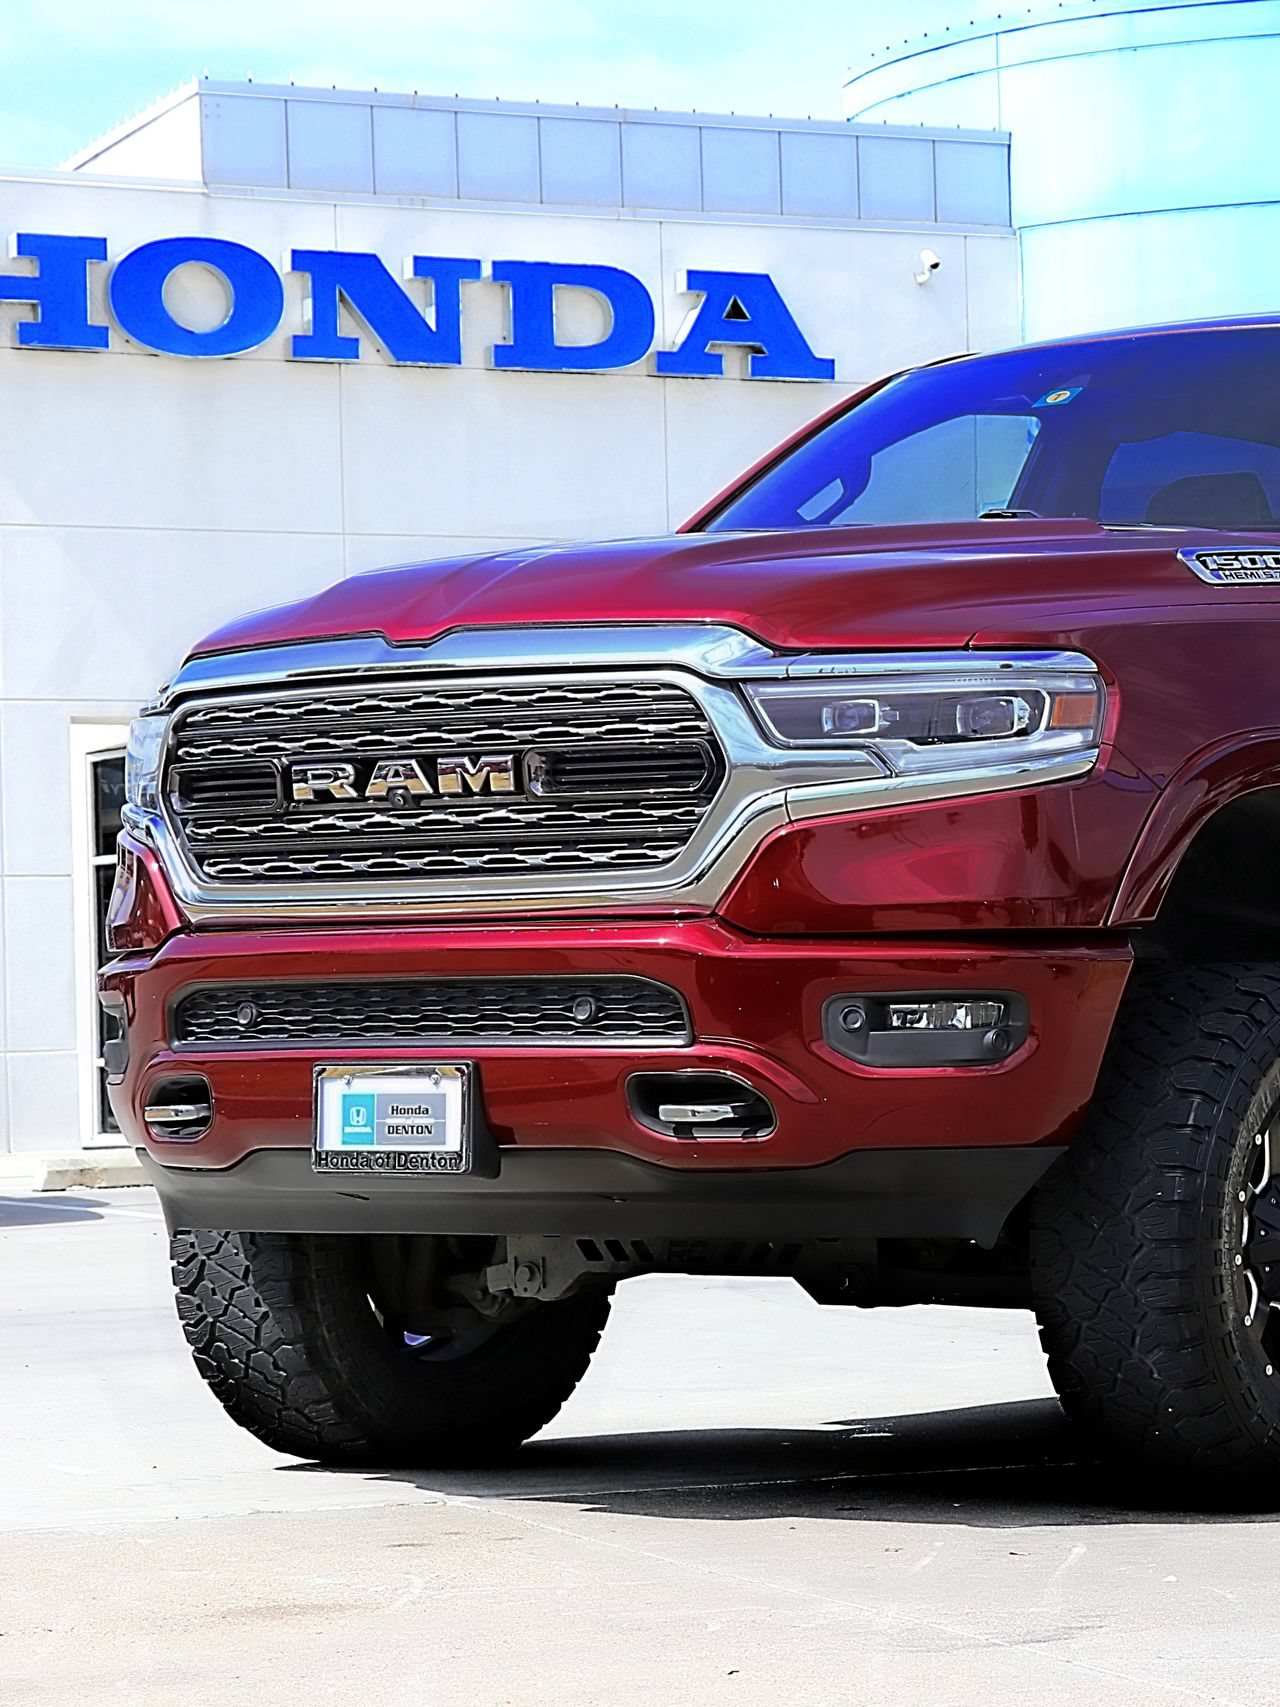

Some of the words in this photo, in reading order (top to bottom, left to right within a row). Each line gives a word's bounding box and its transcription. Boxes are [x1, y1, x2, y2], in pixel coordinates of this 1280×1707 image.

[0, 232, 836, 381] HONDA
[1223, 570, 1261, 581] HEMI
[292, 755, 516, 801] RAM
[391, 1105, 429, 1115] Honda
[387, 1125, 433, 1135] DENTON
[319, 1153, 369, 1168] Honda
[375, 1152, 391, 1168] of
[396, 1152, 459, 1169] Denton
